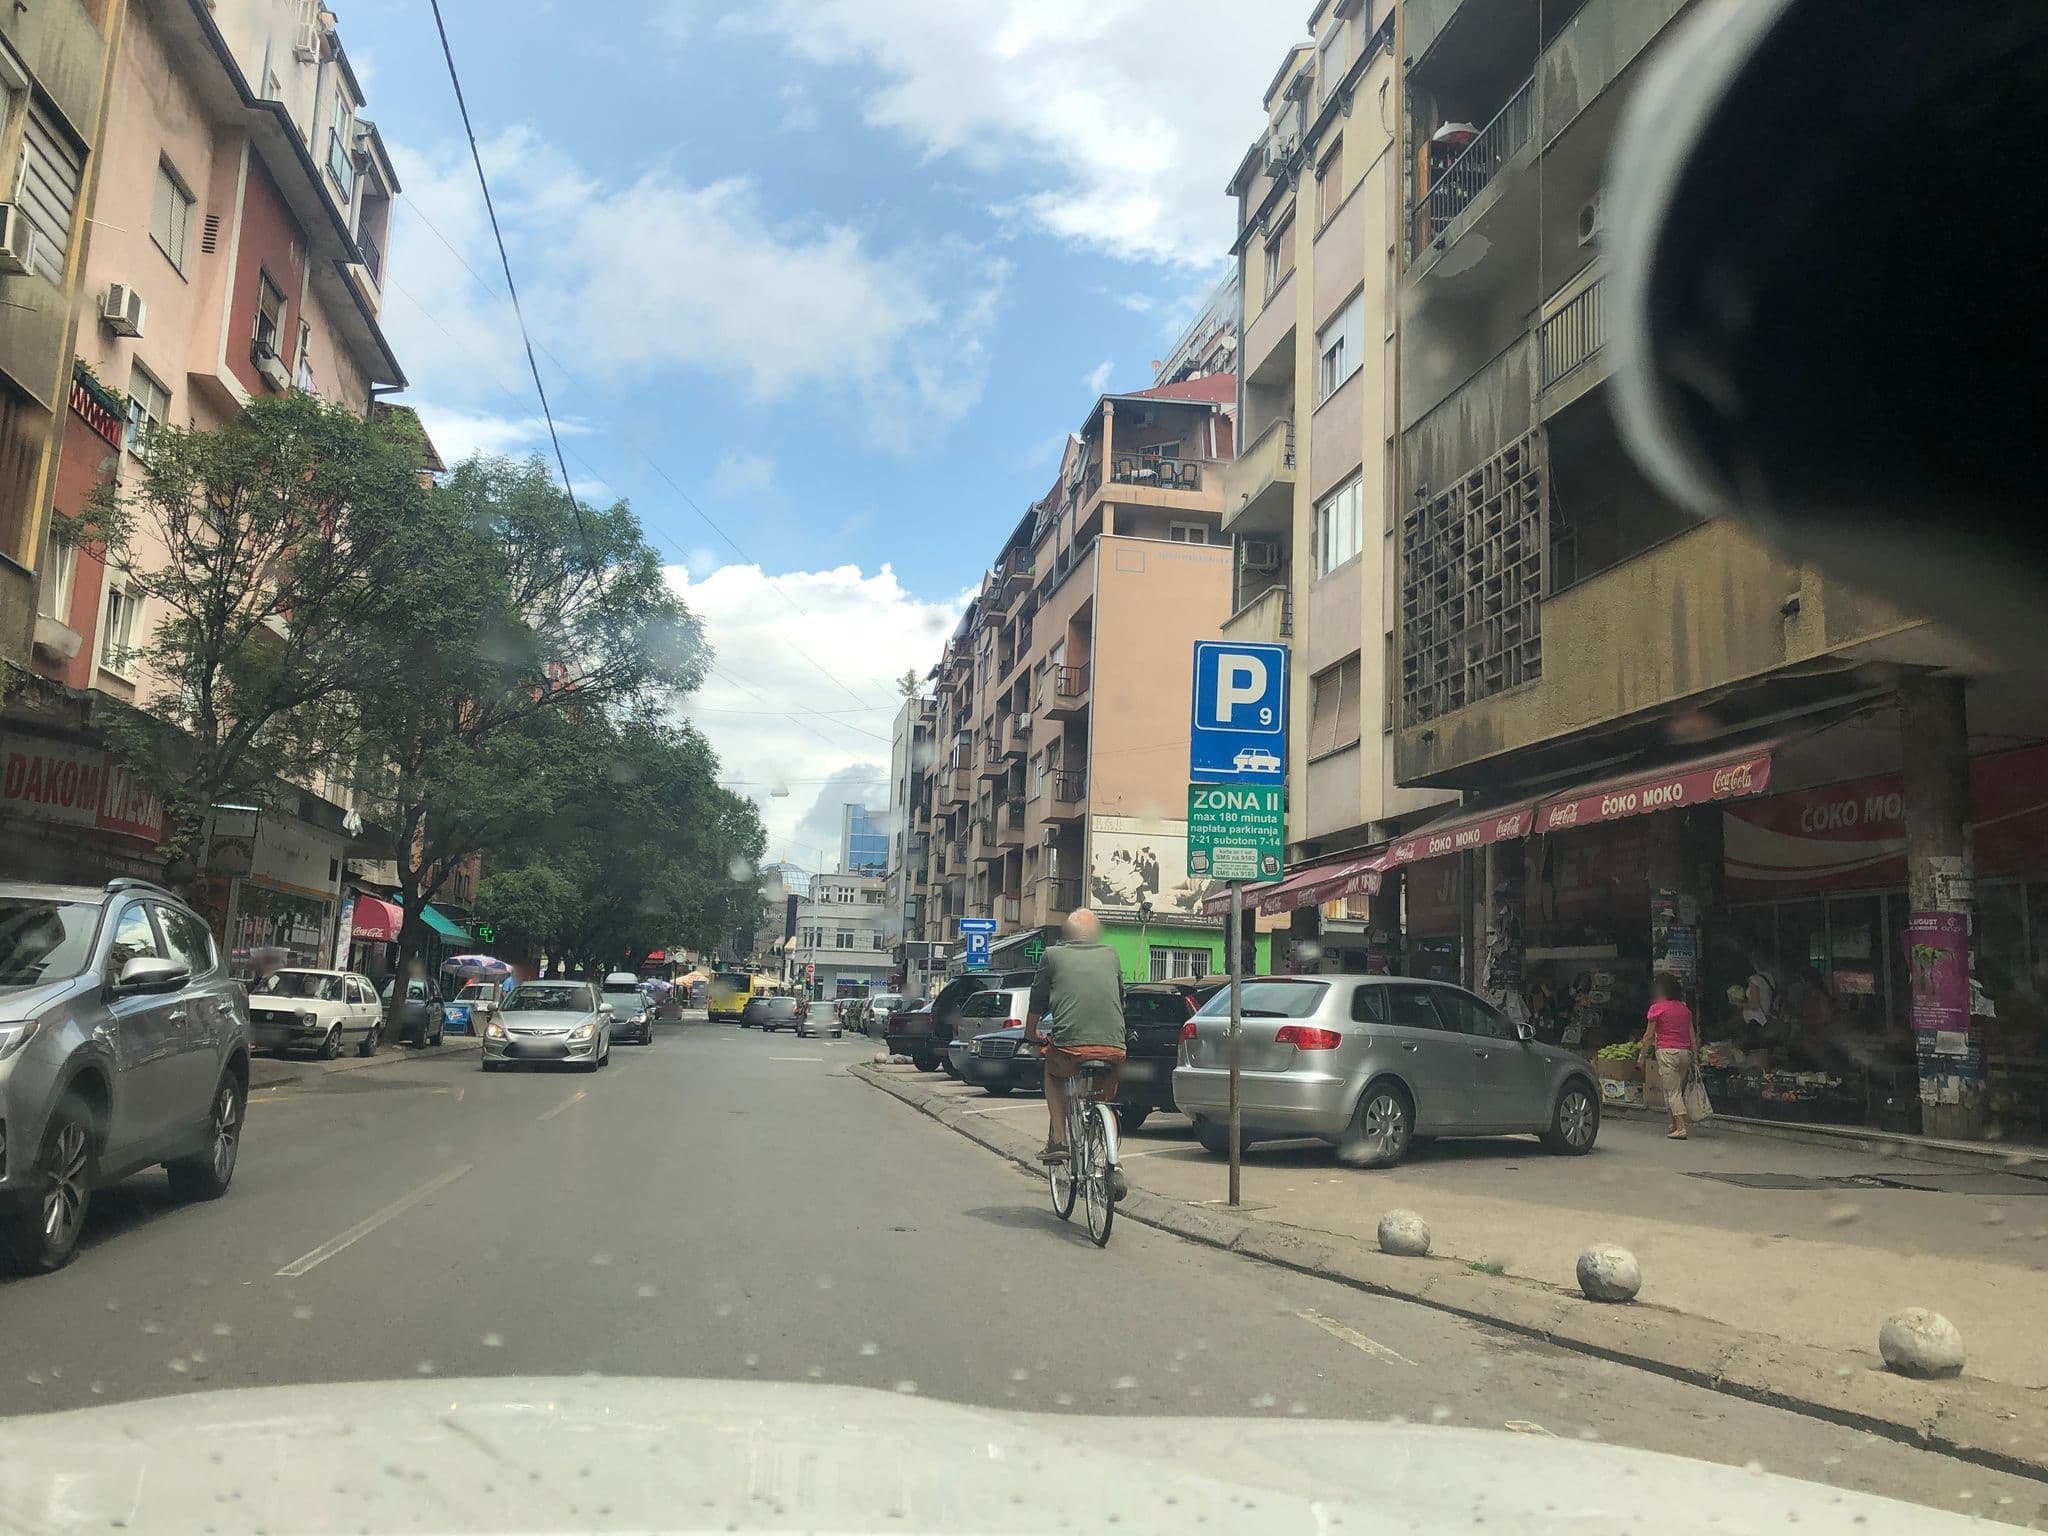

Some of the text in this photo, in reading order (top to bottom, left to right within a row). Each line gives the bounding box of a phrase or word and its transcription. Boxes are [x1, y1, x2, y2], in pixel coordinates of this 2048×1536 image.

[1216, 653, 1272, 725] P 9
[4, 751, 100, 810] DAKOM
[1194, 791, 1278, 811] ZONA II
[1602, 783, 1683, 815] ČOKO MOKO
[1193, 812, 1278, 823] max 180 minuta
[1190, 824, 1279, 836] naplata parkiranja
[1190, 835, 1281, 846] 7-21 subotom 7-14
[1428, 828, 1480, 853] ČOKO MOKO
[972, 935, 985, 952] P
